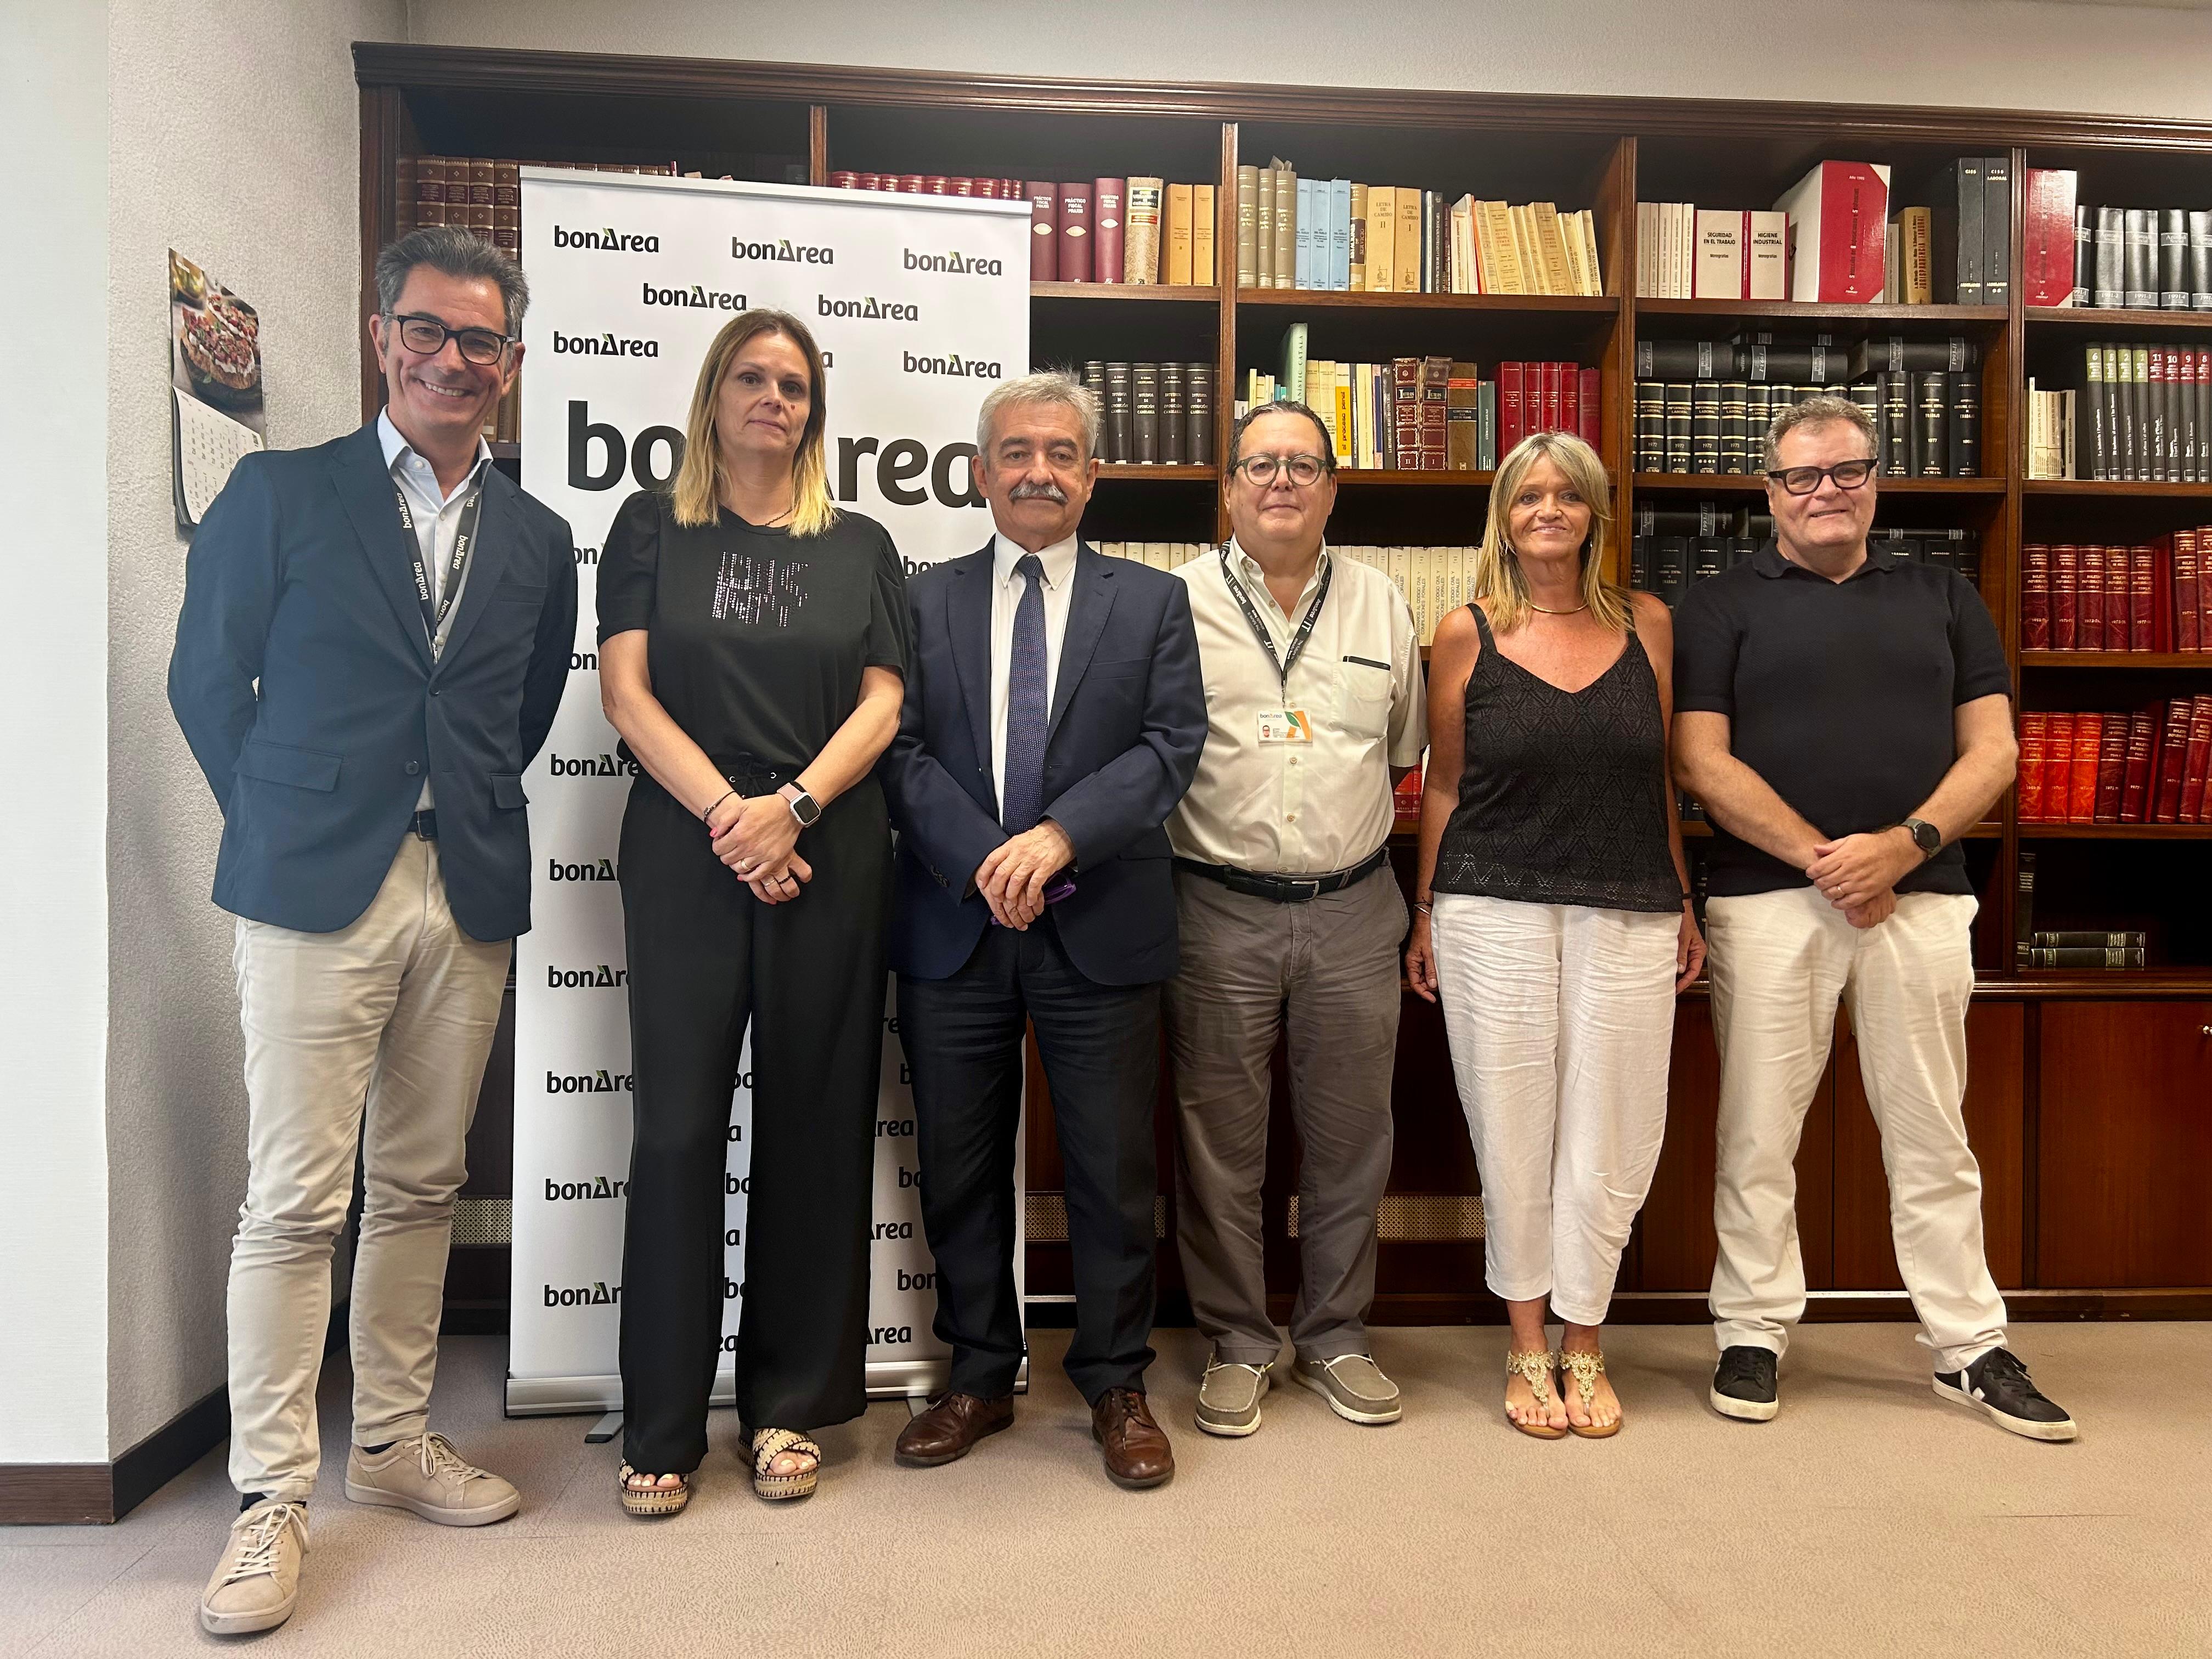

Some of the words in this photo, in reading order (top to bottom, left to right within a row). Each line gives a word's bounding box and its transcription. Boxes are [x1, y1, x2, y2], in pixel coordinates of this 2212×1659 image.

[554, 225, 659, 253] bonArea
[1917, 216, 1926, 238] LABORAL
[732, 237, 833, 264] bonArea
[904, 249, 1002, 276] bonArea
[1918, 243, 1927, 289] JURISPRUDENCIA
[643, 283, 747, 311] bonArea
[818, 295, 918, 321] bonArea
[554, 331, 658, 357] bonArea
[904, 351, 1001, 379] bonArea
[2167, 355, 2177, 363] 10
[568, 400, 986, 509] borea
[397, 493, 412, 529] bonArea
[453, 534, 468, 569] bonArea
[414, 562, 428, 601] bonArea
[1226, 574, 1234, 584] IT
[1301, 620, 1312, 633] IT
[1263, 640, 1273, 649] IT
[551, 753, 639, 777] bonAre
[550, 859, 619, 881] bonA
[548, 965, 629, 988] bonAr
[547, 1070, 633, 1093] bonAre
[545, 1176, 630, 1201] bonAr
[544, 1282, 622, 1307] bonAr
